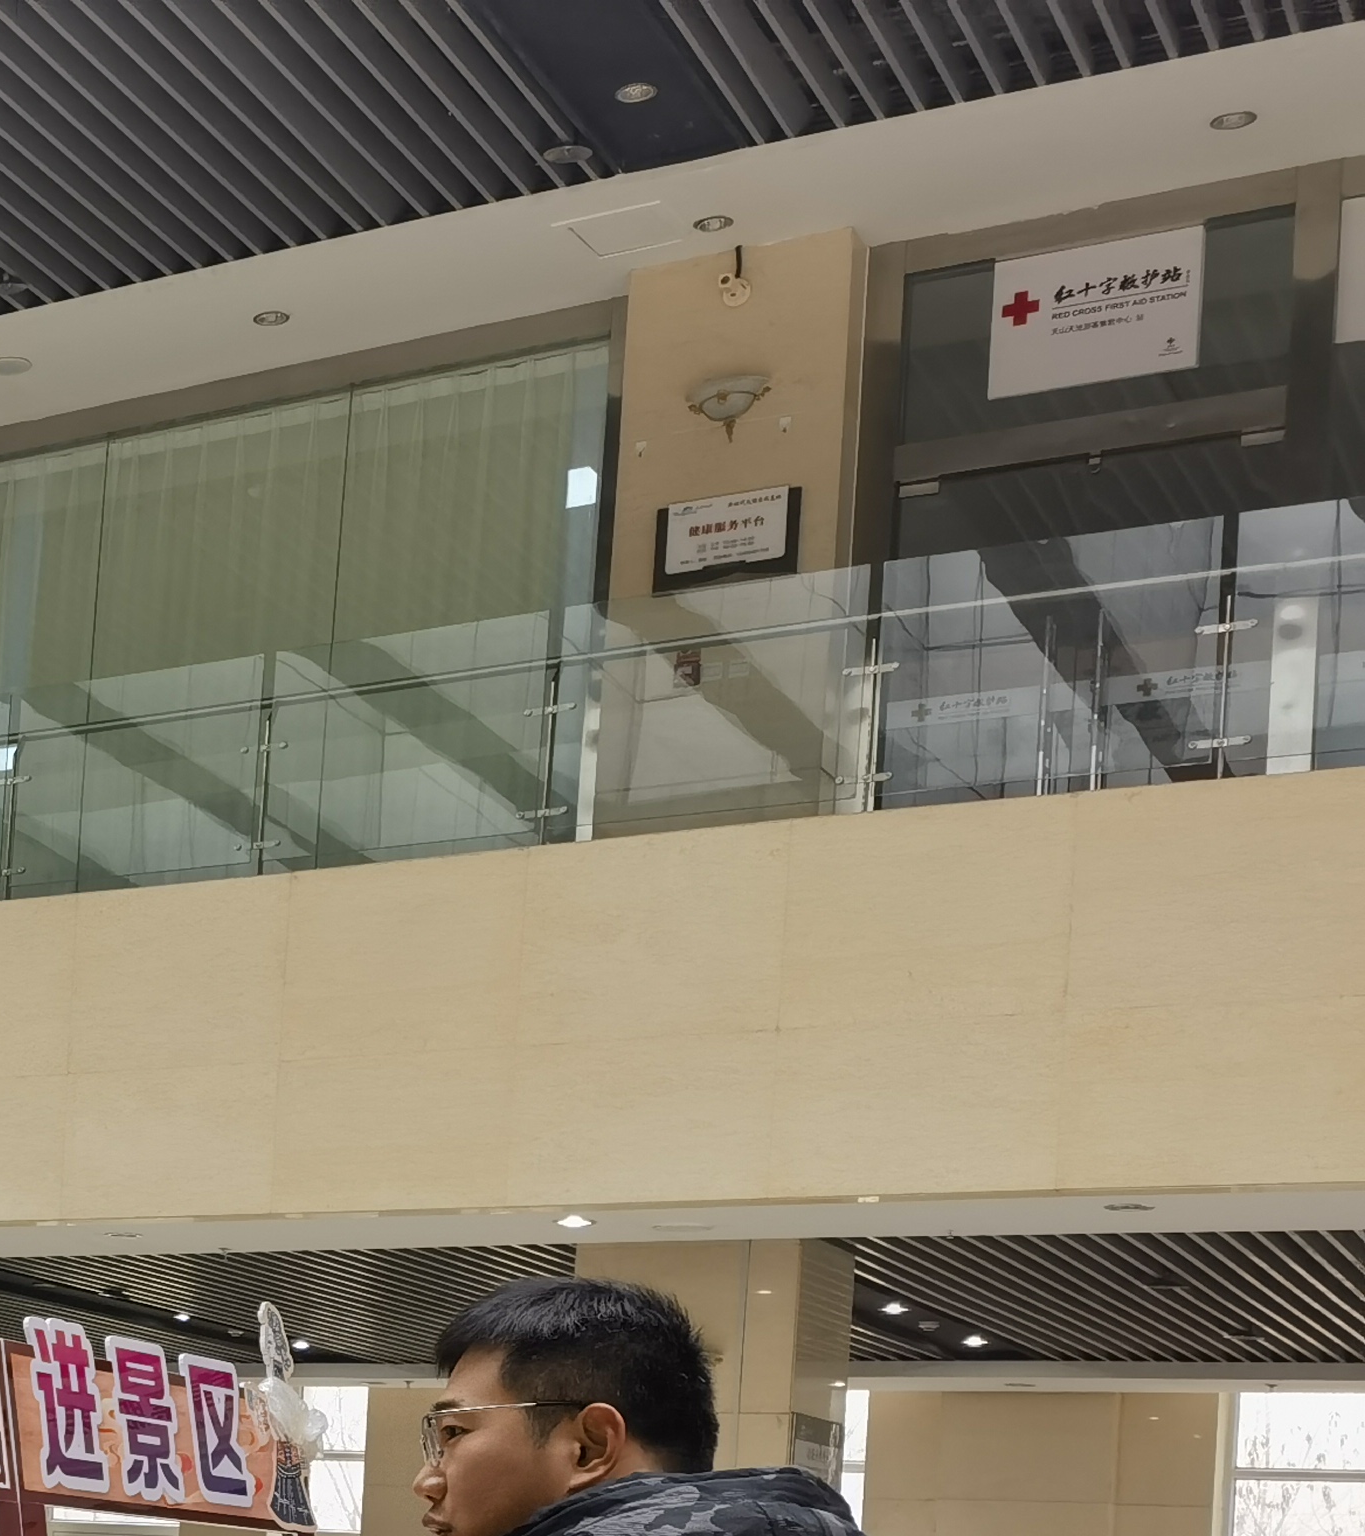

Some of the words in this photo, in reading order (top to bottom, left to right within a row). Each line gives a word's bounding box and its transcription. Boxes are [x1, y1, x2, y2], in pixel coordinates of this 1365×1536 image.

[1054, 266, 1183, 303] 红十字救护站
[1051, 311, 1071, 321] RED
[1072, 305, 1103, 318] CROSS
[1105, 300, 1130, 313] FIRST
[1131, 297, 1148, 306] AID
[1149, 290, 1187, 304] STATION
[33, 1326, 250, 1498] 进景区
